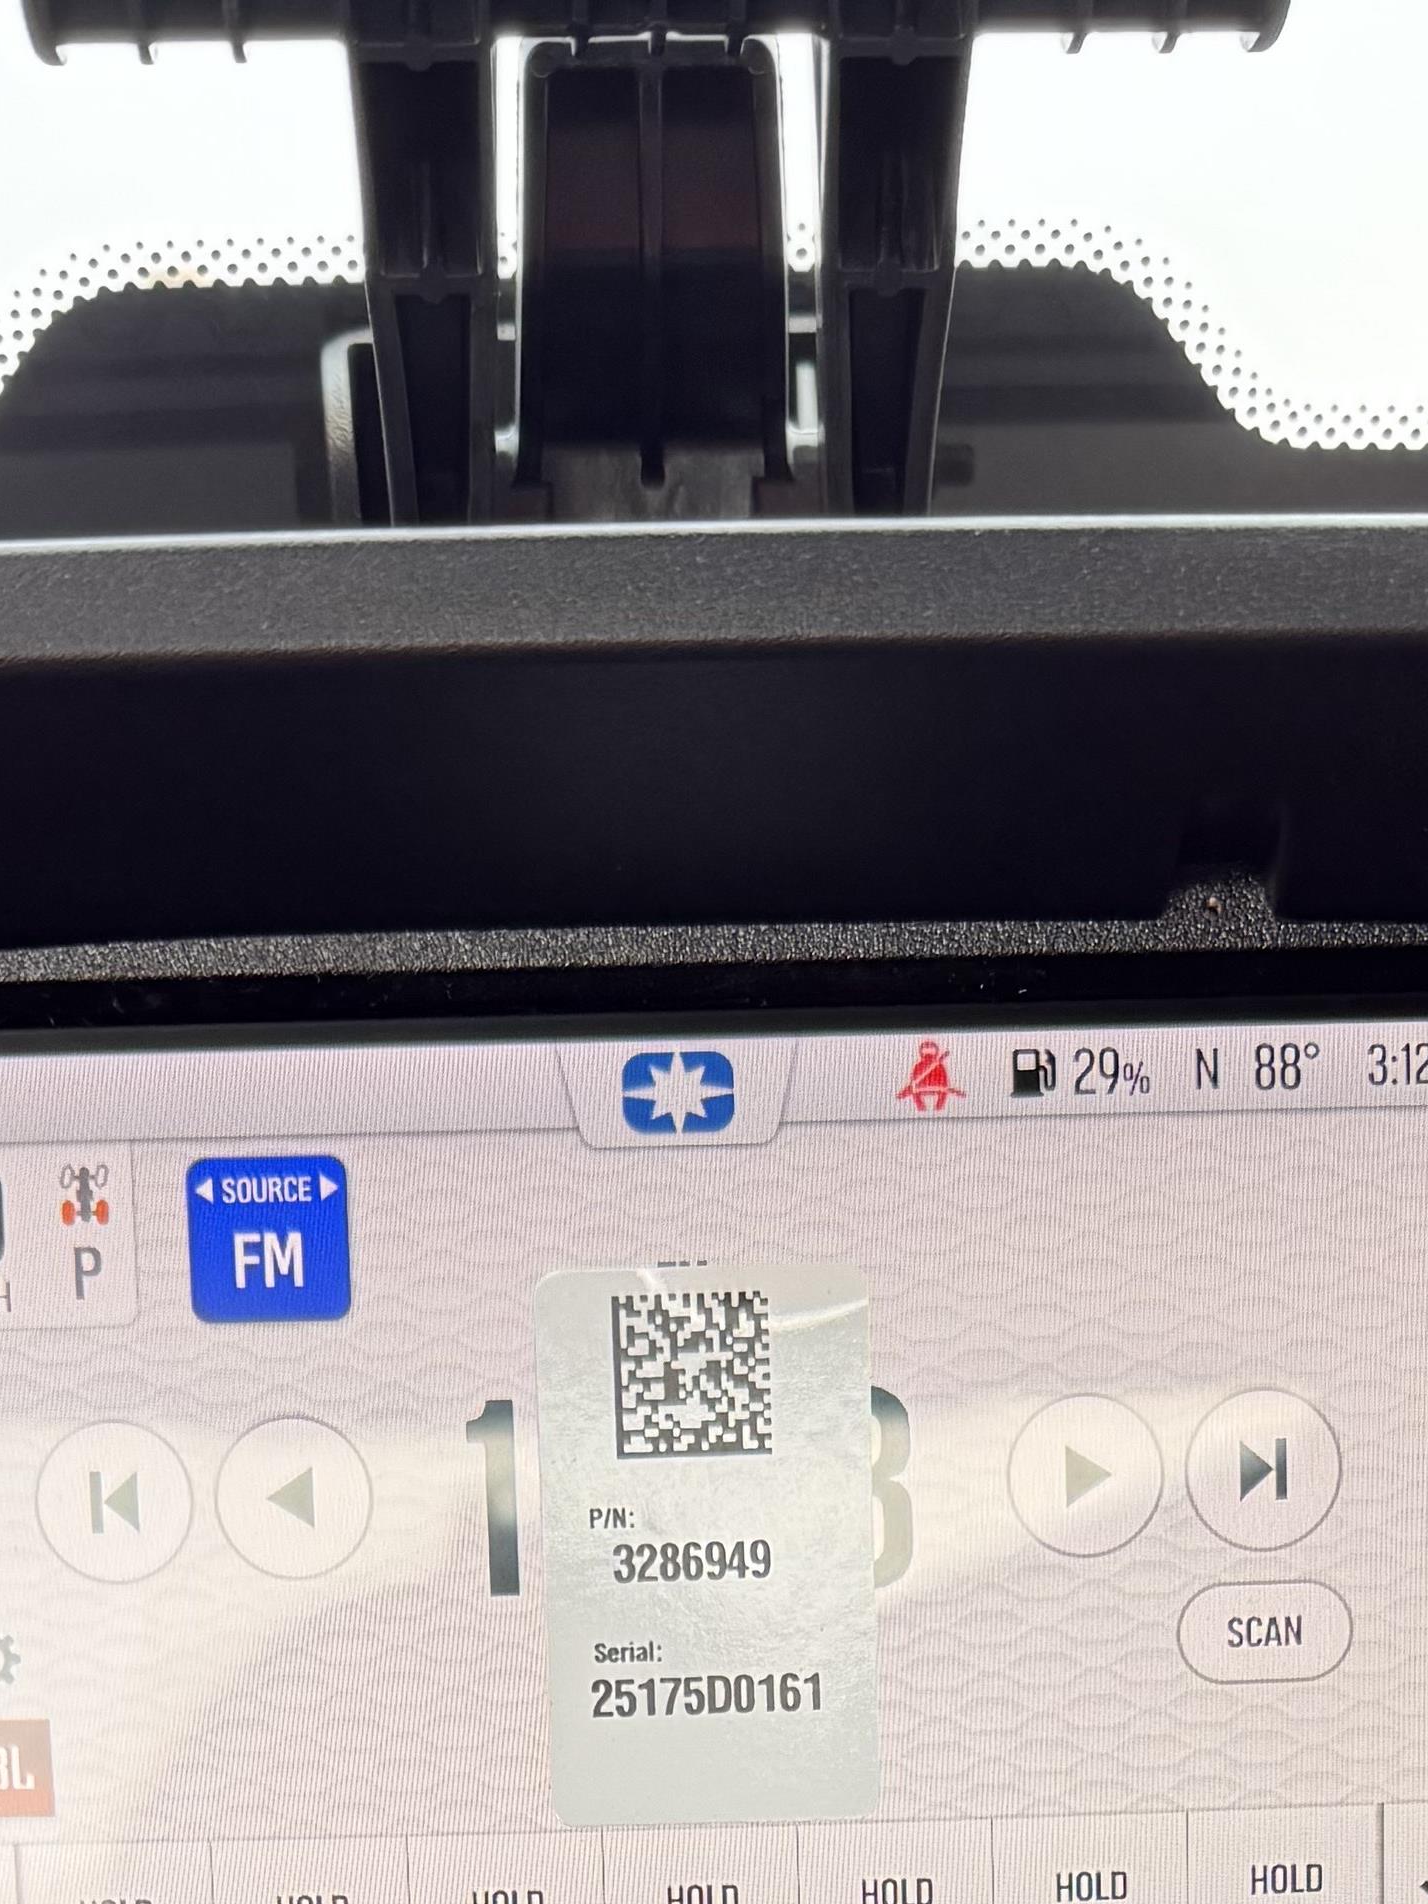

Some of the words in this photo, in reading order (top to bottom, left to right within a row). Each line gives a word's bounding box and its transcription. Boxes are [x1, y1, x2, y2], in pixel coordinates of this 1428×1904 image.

[1075, 1048, 1150, 1096] 29%
[1196, 1048, 1219, 1090] N
[222, 1176, 312, 1203] SOURCE
[74, 1246, 101, 1300] P
[232, 1230, 304, 1289] FM
[588, 1507, 635, 1530] P/N:
[611, 1538, 772, 1584] 3286949
[1228, 1615, 1302, 1647] SCAN
[593, 1641, 663, 1664] Serial:
[590, 1672, 823, 1719] 25175D0161
[1056, 1871, 1127, 1902] HOLD
[1251, 1864, 1322, 1895] HOLD
